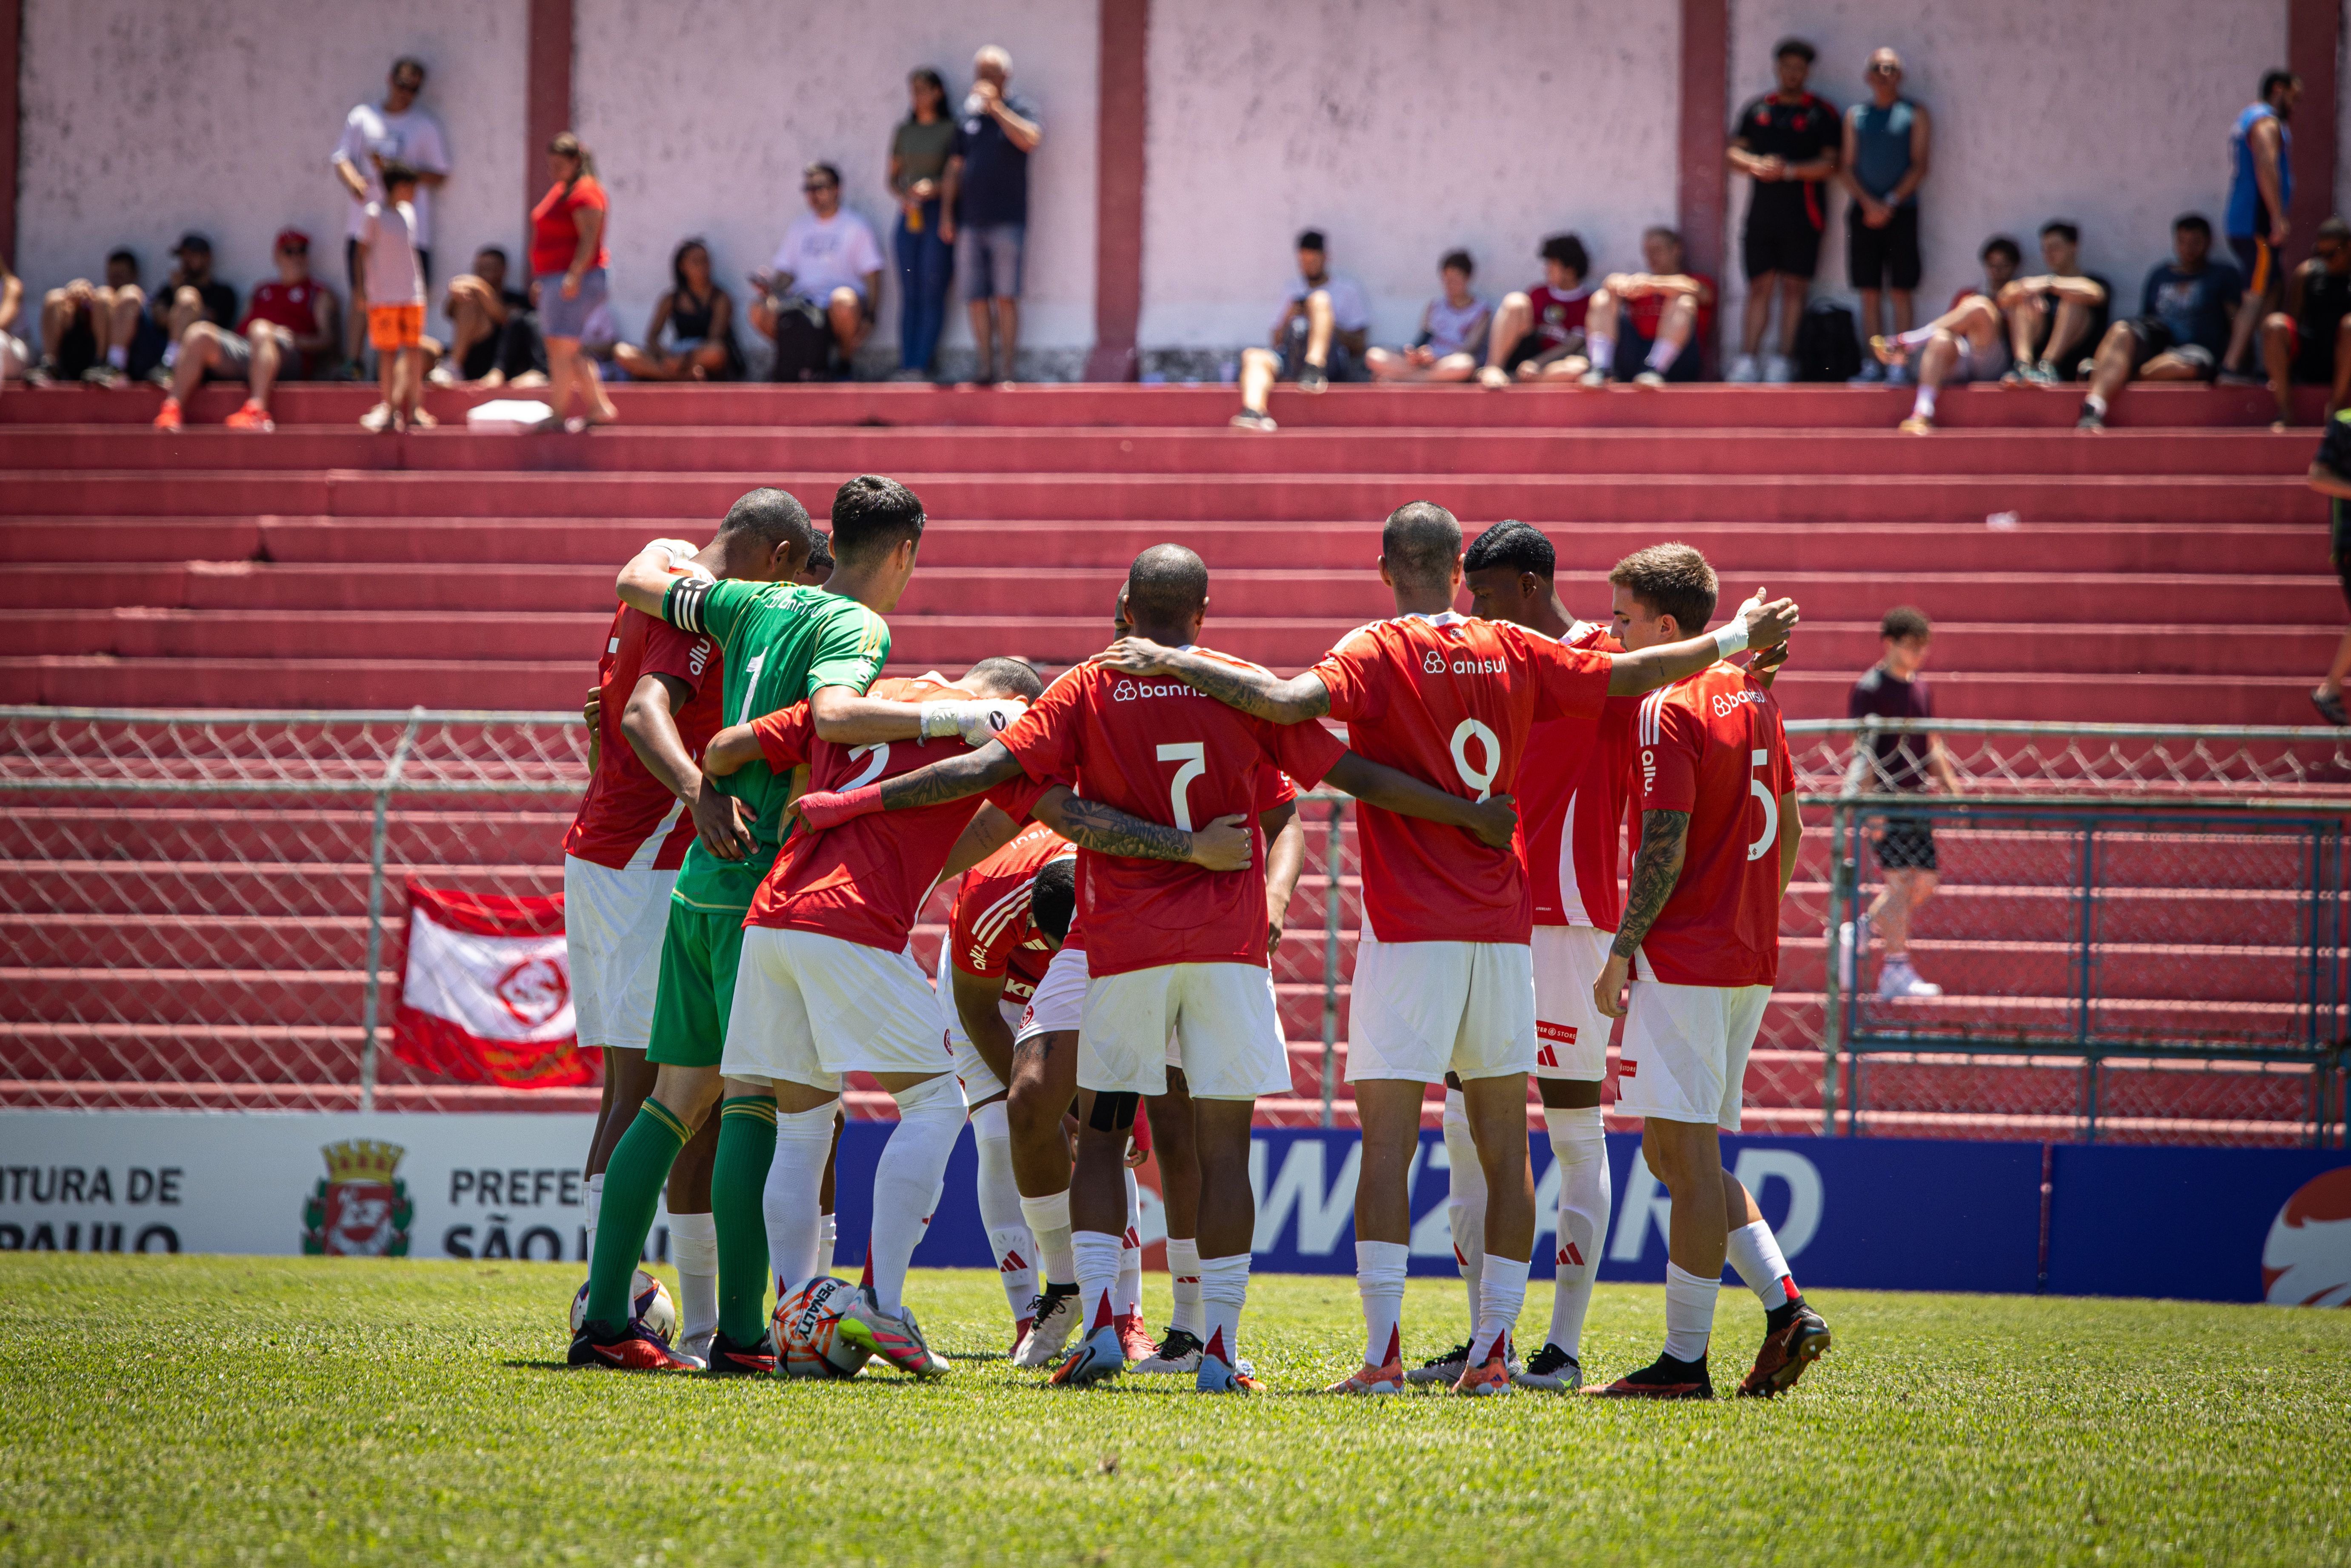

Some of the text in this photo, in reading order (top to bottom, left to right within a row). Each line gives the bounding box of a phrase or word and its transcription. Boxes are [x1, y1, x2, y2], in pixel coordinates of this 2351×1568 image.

[736, 646, 768, 726] 1
[1156, 742, 1205, 833] 7
[1450, 717, 1500, 805] 9
[1747, 748, 1778, 861] 5
[1557, 1031, 1577, 1040] STORE
[127, 1166, 184, 1205] DE
[799, 1282, 837, 1341] PENALTY
